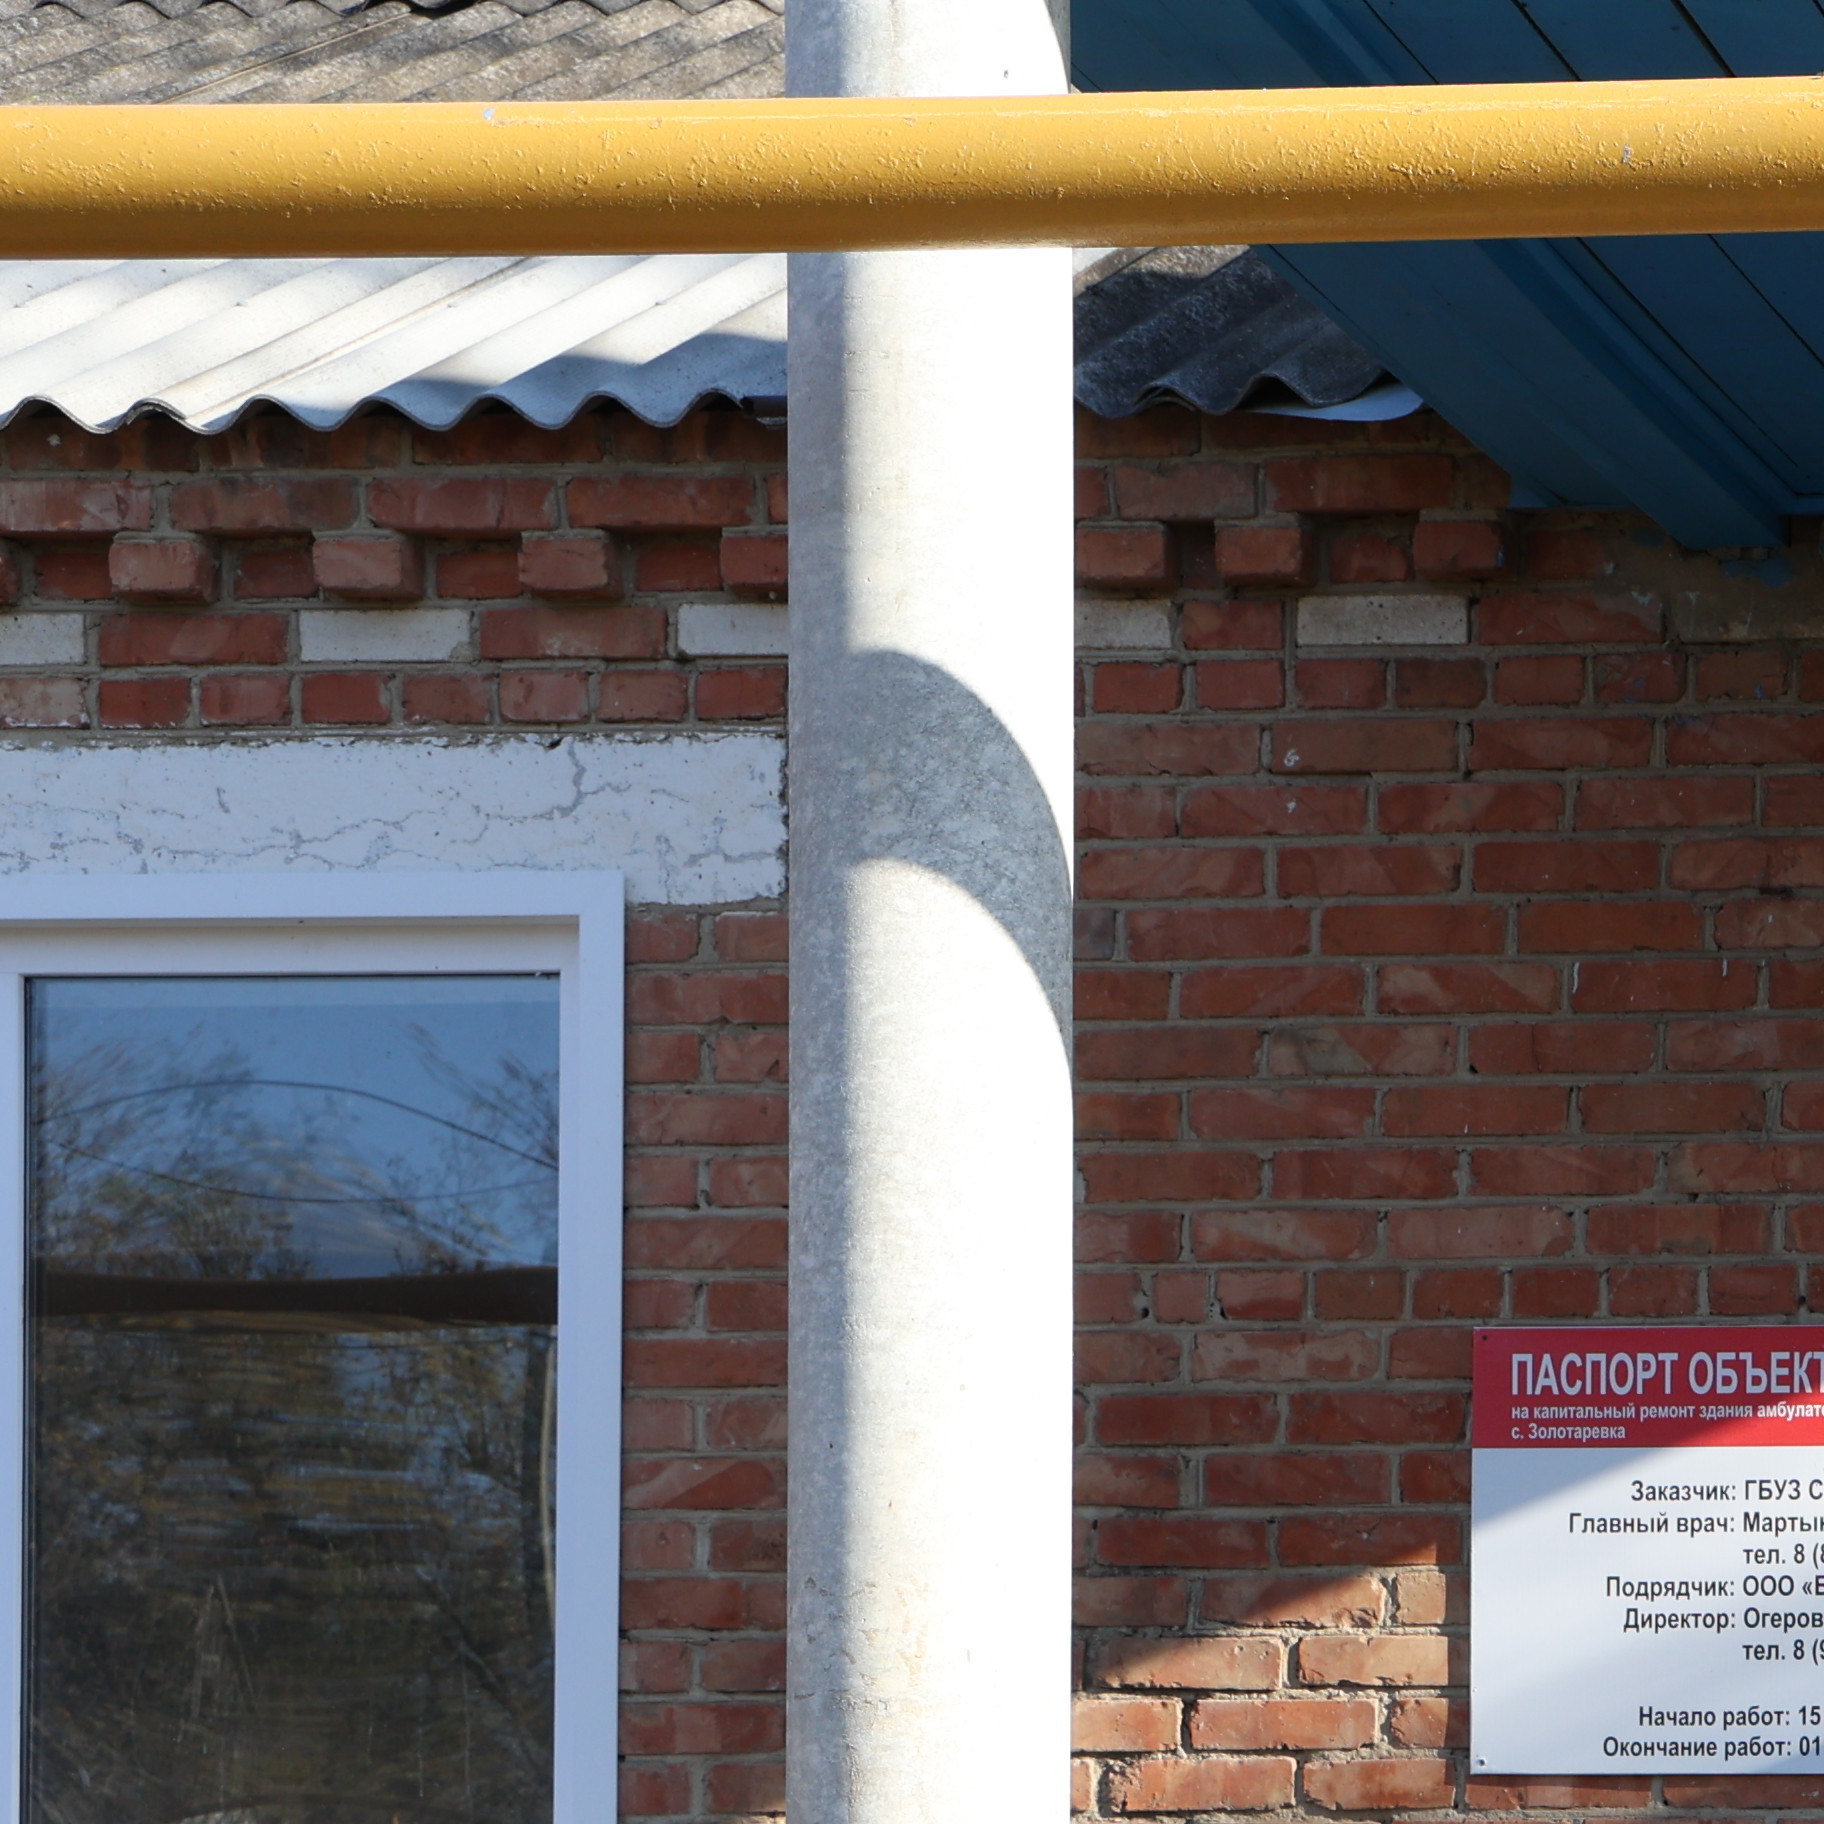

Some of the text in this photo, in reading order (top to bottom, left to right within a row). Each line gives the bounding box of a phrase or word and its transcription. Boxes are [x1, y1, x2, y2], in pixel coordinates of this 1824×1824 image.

[1511, 1352, 1679, 1396] ПАСПОРТ
[1511, 1406, 1530, 1419] на
[1533, 1402, 1636, 1419] капитальный
[1640, 1405, 1696, 1422] ремонт
[1698, 1405, 1753, 1420] здания
[1511, 1422, 1626, 1443] с. Золотаревка
[1631, 1480, 1736, 1501] Заказчик:
[1744, 1479, 1801, 1500] ГБУЗ
[1569, 1512, 1669, 1533] Главный
[1676, 1516, 1735, 1538] врач:
[1742, 1548, 1786, 1564] тел.
[1793, 1543, 1806, 1564] 8
[1606, 1576, 1735, 1602] Подрядчик:
[1742, 1575, 1795, 1597] ООО
[1623, 1608, 1736, 1634] Директор:
[1743, 1607, 1824, 1634] Огеров
[1741, 1644, 1786, 1660] тел.
[1793, 1639, 1805, 1660] 8
[1639, 1706, 1717, 1726] Начало
[1723, 1705, 1790, 1731] работ:
[1798, 1705, 1821, 1726] 15
[1603, 1736, 1718, 1757] Окончание
[1724, 1736, 1791, 1761] работ:
[1799, 1736, 1820, 1756] 01
